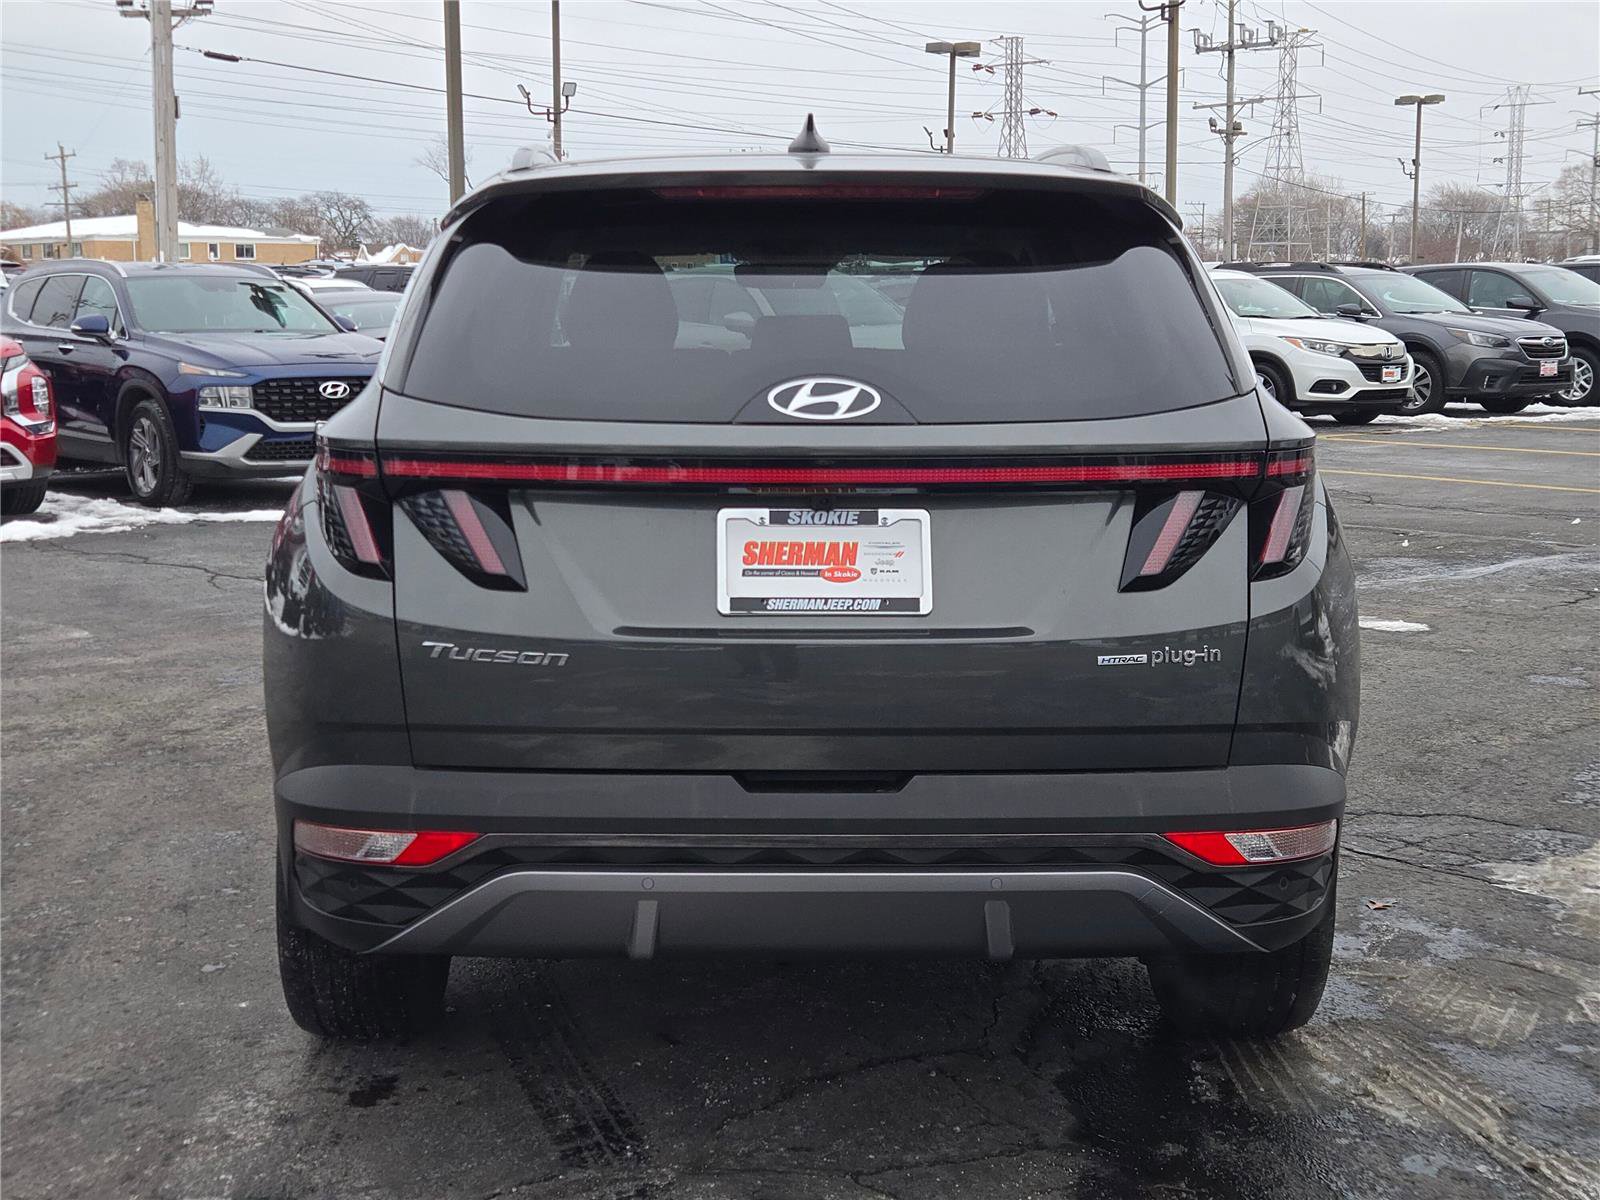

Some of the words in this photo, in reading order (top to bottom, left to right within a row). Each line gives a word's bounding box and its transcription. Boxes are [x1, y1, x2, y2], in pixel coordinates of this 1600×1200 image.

[787, 511, 860, 525] SKOKIE
[742, 541, 859, 566] SHERMAN
[766, 598, 881, 611] SHERMANJEEP.COM
[1101, 656, 1144, 664] HTRAC
[1151, 645, 1221, 668] plug-in
